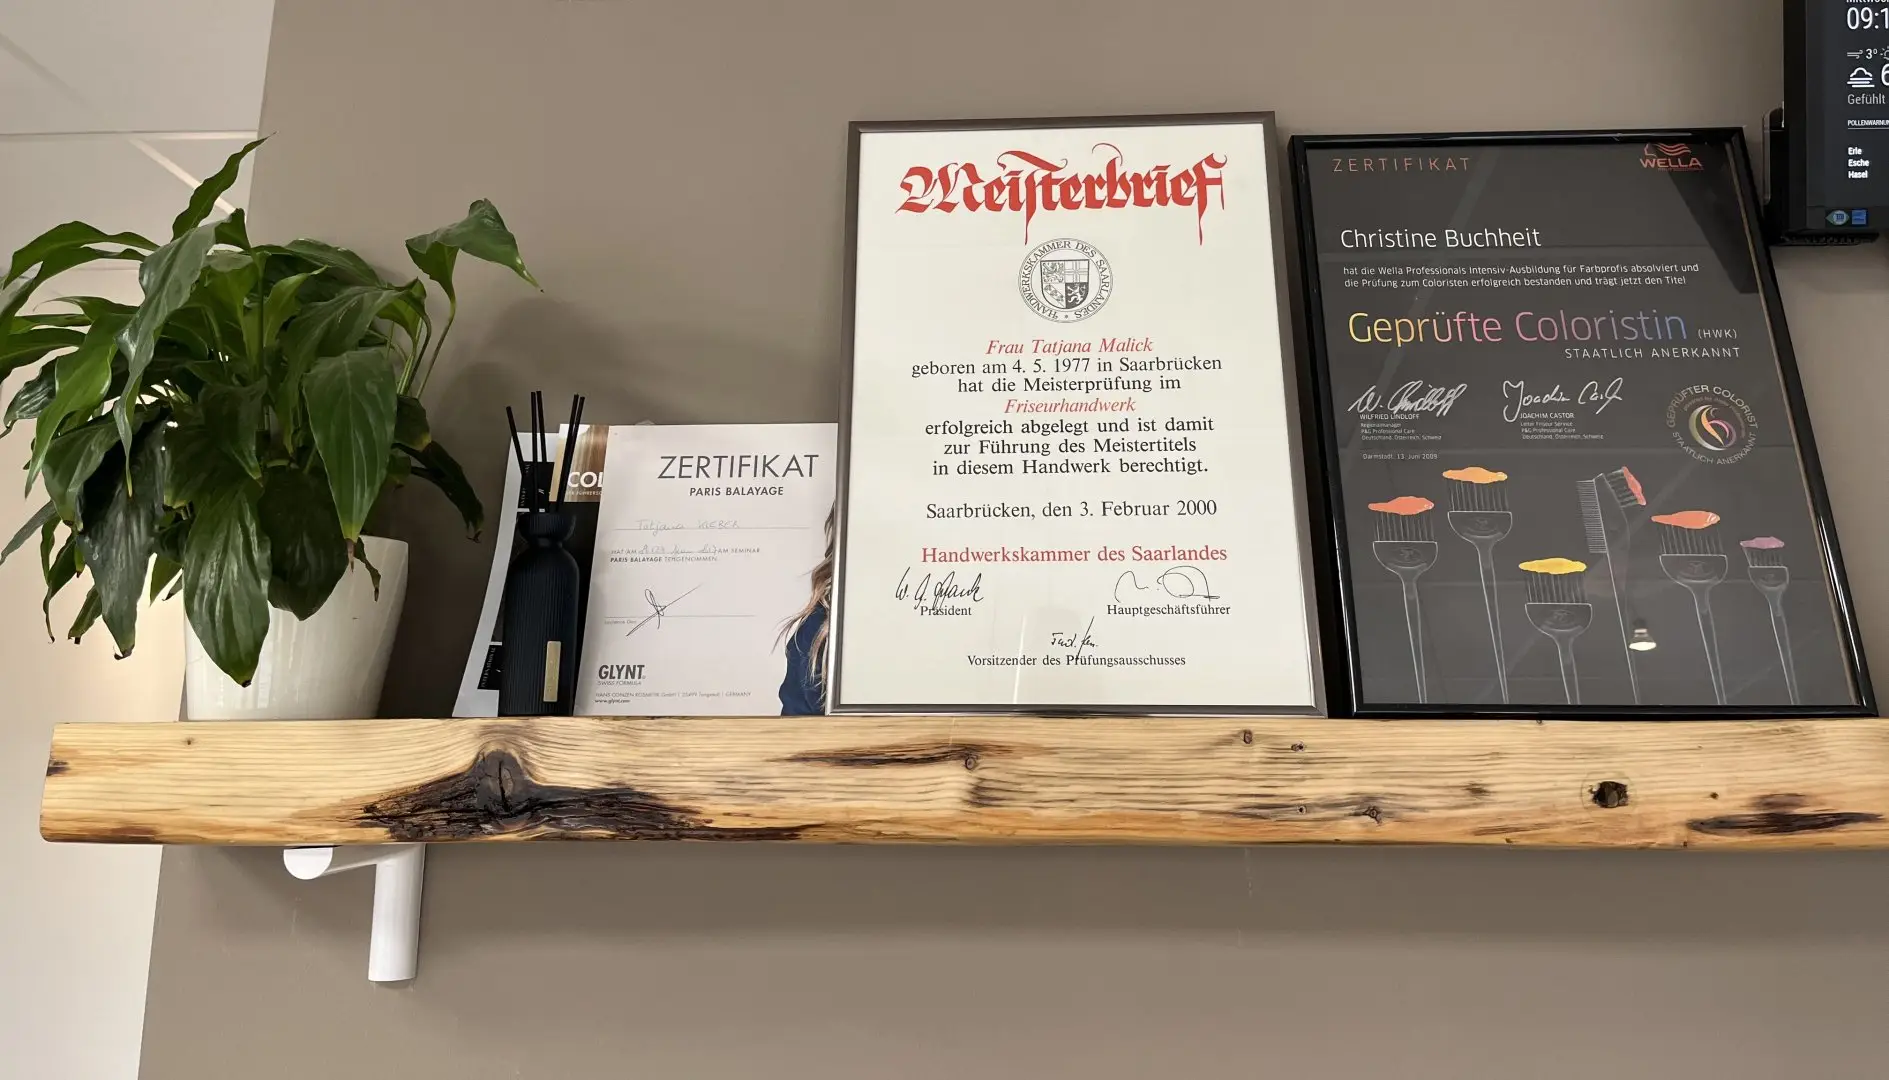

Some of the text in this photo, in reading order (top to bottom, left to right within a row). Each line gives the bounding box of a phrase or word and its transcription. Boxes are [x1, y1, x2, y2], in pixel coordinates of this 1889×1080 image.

[1846, 6, 1889, 30] 09:1
[1848, 93, 1886, 105] Gefühlt
[1848, 146, 1862, 156] Erle
[1333, 157, 1471, 173] ZERTIFIKAT
[1640, 157, 1703, 169] WELLA
[1848, 158, 1870, 167] Esche
[1848, 170, 1868, 178] Hasel
[1340, 227, 1542, 249] Christine Buchheit
[1343, 263, 1699, 275] hat die Wella Professionals Intensiv-Ausbildung für Farbprofis absolviert und
[1022, 241, 1109, 319] HANDWERKSKAMMER DES SAARLANDES
[1344, 274, 1686, 288] die Prüfung zum Coloristen erfolgreich bestanden und trägt jetzt den Titel
[1348, 309, 1738, 347] Geprüfte Coloristin (HWK)
[985, 337, 1153, 355] Frau Tatjana Malick
[1564, 346, 1740, 360] STAATLICH ANERKANNT
[911, 357, 1222, 377] geboren am 4. 5. 1977 in Saarbrücken
[958, 376, 1181, 393] hat die Meisterprüfung im
[1004, 397, 1136, 413] Friseurhandwerk
[1713, 386, 1758, 428] COLORIST
[925, 417, 1214, 437] erfolgreich abgelegt und ist damit
[944, 437, 1197, 456] zur Führung des Meistertitels
[1673, 431, 1713, 463] STAATLICH
[658, 454, 819, 479] ZERTIFIKAT
[933, 458, 1208, 475] in diesem Handwerk berechtigt.
[689, 486, 784, 497] PARIS BALAYAGE
[926, 500, 1217, 520] Saarbrücken, den 3. Februar 2000
[922, 544, 1227, 563] Handwerkskammer des Saarlandes
[920, 604, 972, 617] Präsident
[1107, 603, 1231, 617] Hauptgeschäftsführer
[968, 653, 1186, 669] Vorsitzender des Prüfungsausschusses
[599, 665, 645, 679] GLYNT
